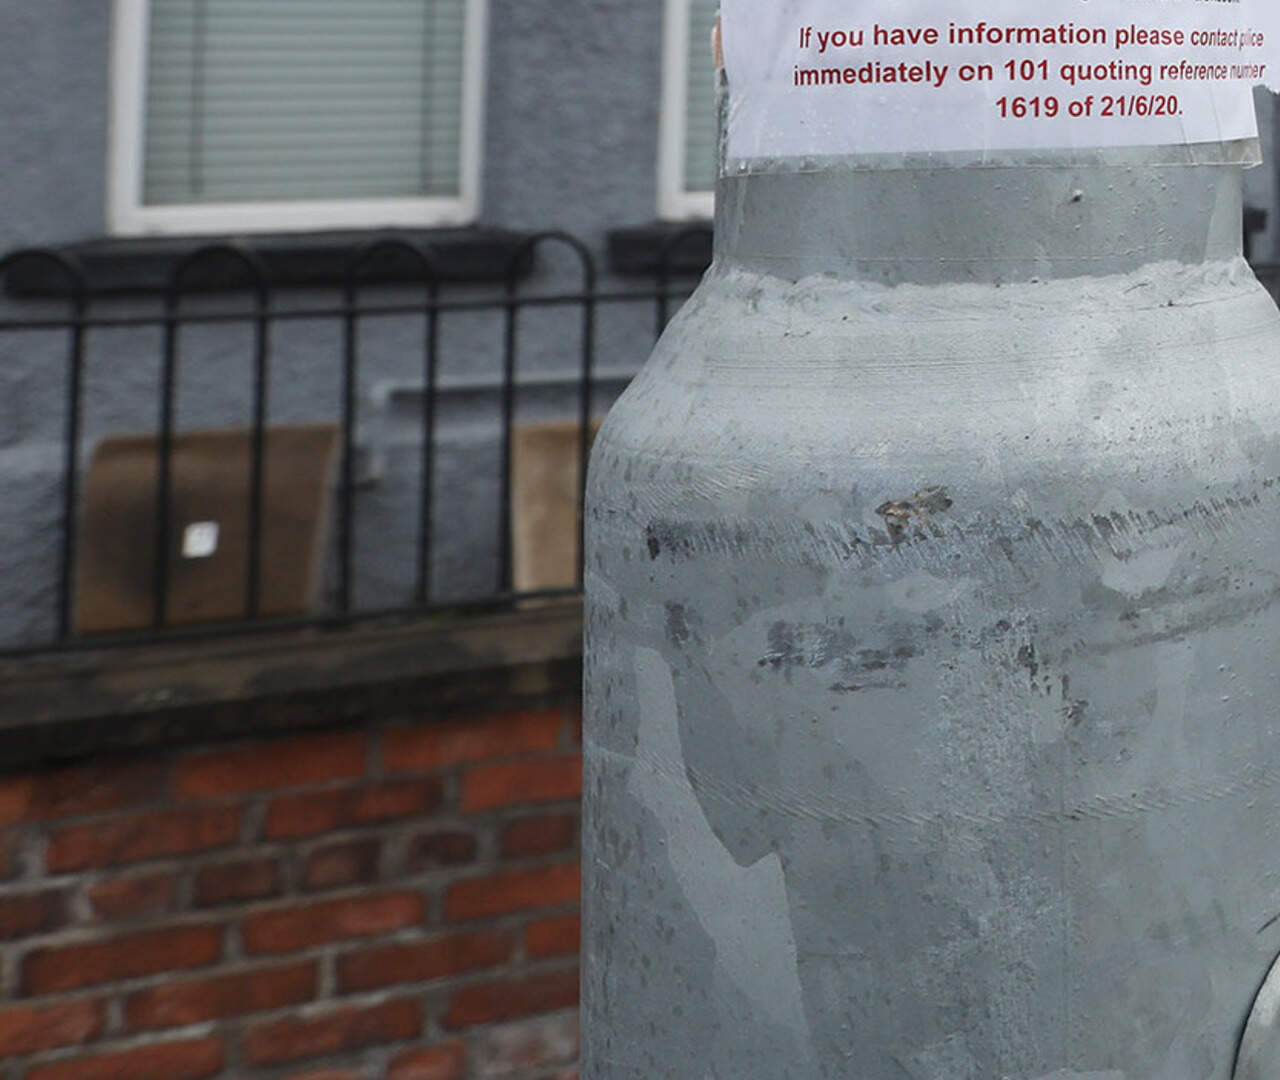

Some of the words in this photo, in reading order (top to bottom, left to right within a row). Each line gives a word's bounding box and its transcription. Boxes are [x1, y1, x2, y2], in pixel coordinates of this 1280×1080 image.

[800, 26, 812, 48] If
[817, 30, 864, 53] you
[873, 24, 939, 46] have
[949, 22, 1106, 44] information
[1115, 24, 1185, 49] please
[1190, 28, 1237, 47] contact
[794, 60, 949, 88] immediately
[958, 64, 993, 82] on
[1004, 59, 1049, 81] 101
[1060, 59, 1153, 86] quoting
[1159, 60, 1227, 82] reference
[996, 95, 1059, 119] 1619
[1068, 95, 1093, 117] of
[1100, 94, 1184, 118] 21/6/20.
